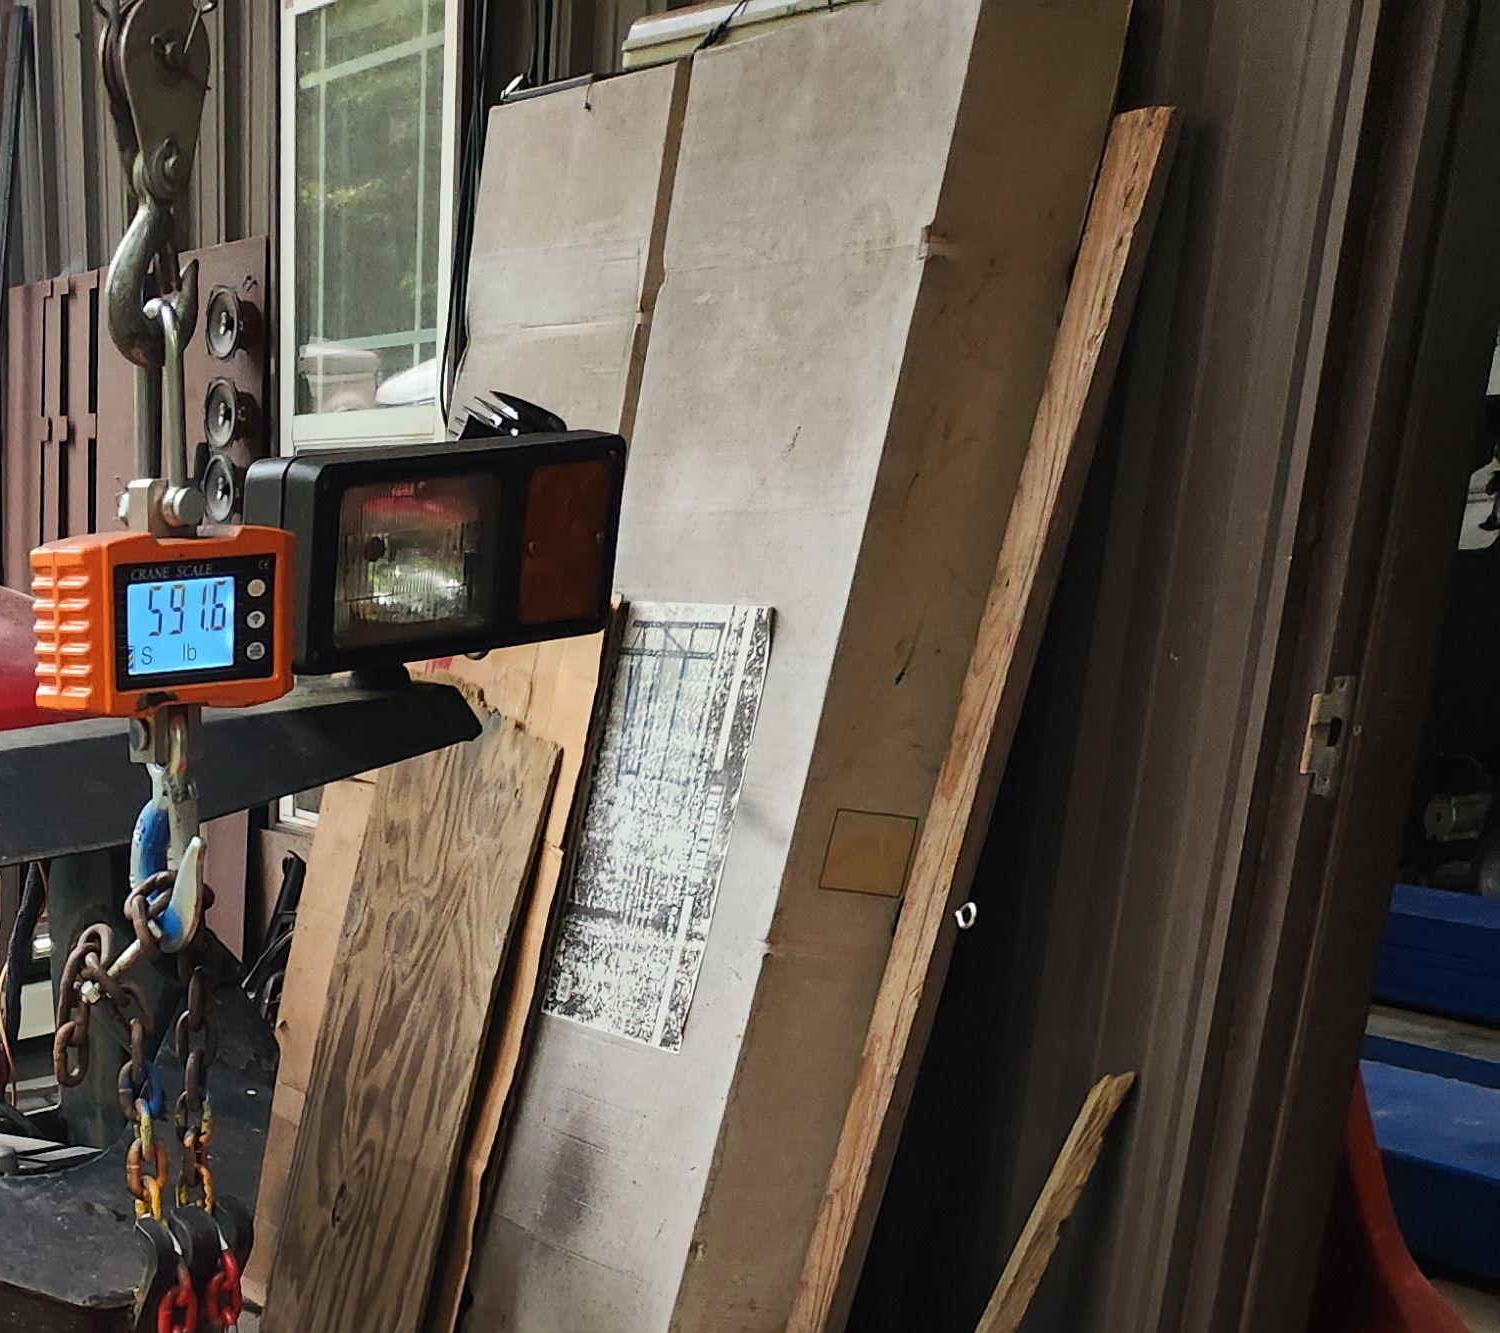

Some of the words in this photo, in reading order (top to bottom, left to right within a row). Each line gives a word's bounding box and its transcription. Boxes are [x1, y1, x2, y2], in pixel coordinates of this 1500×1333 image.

[130, 566, 171, 581] CRANE
[176, 562, 214, 577] SCALE
[141, 645, 153, 666] S
[182, 642, 197, 662] lb
